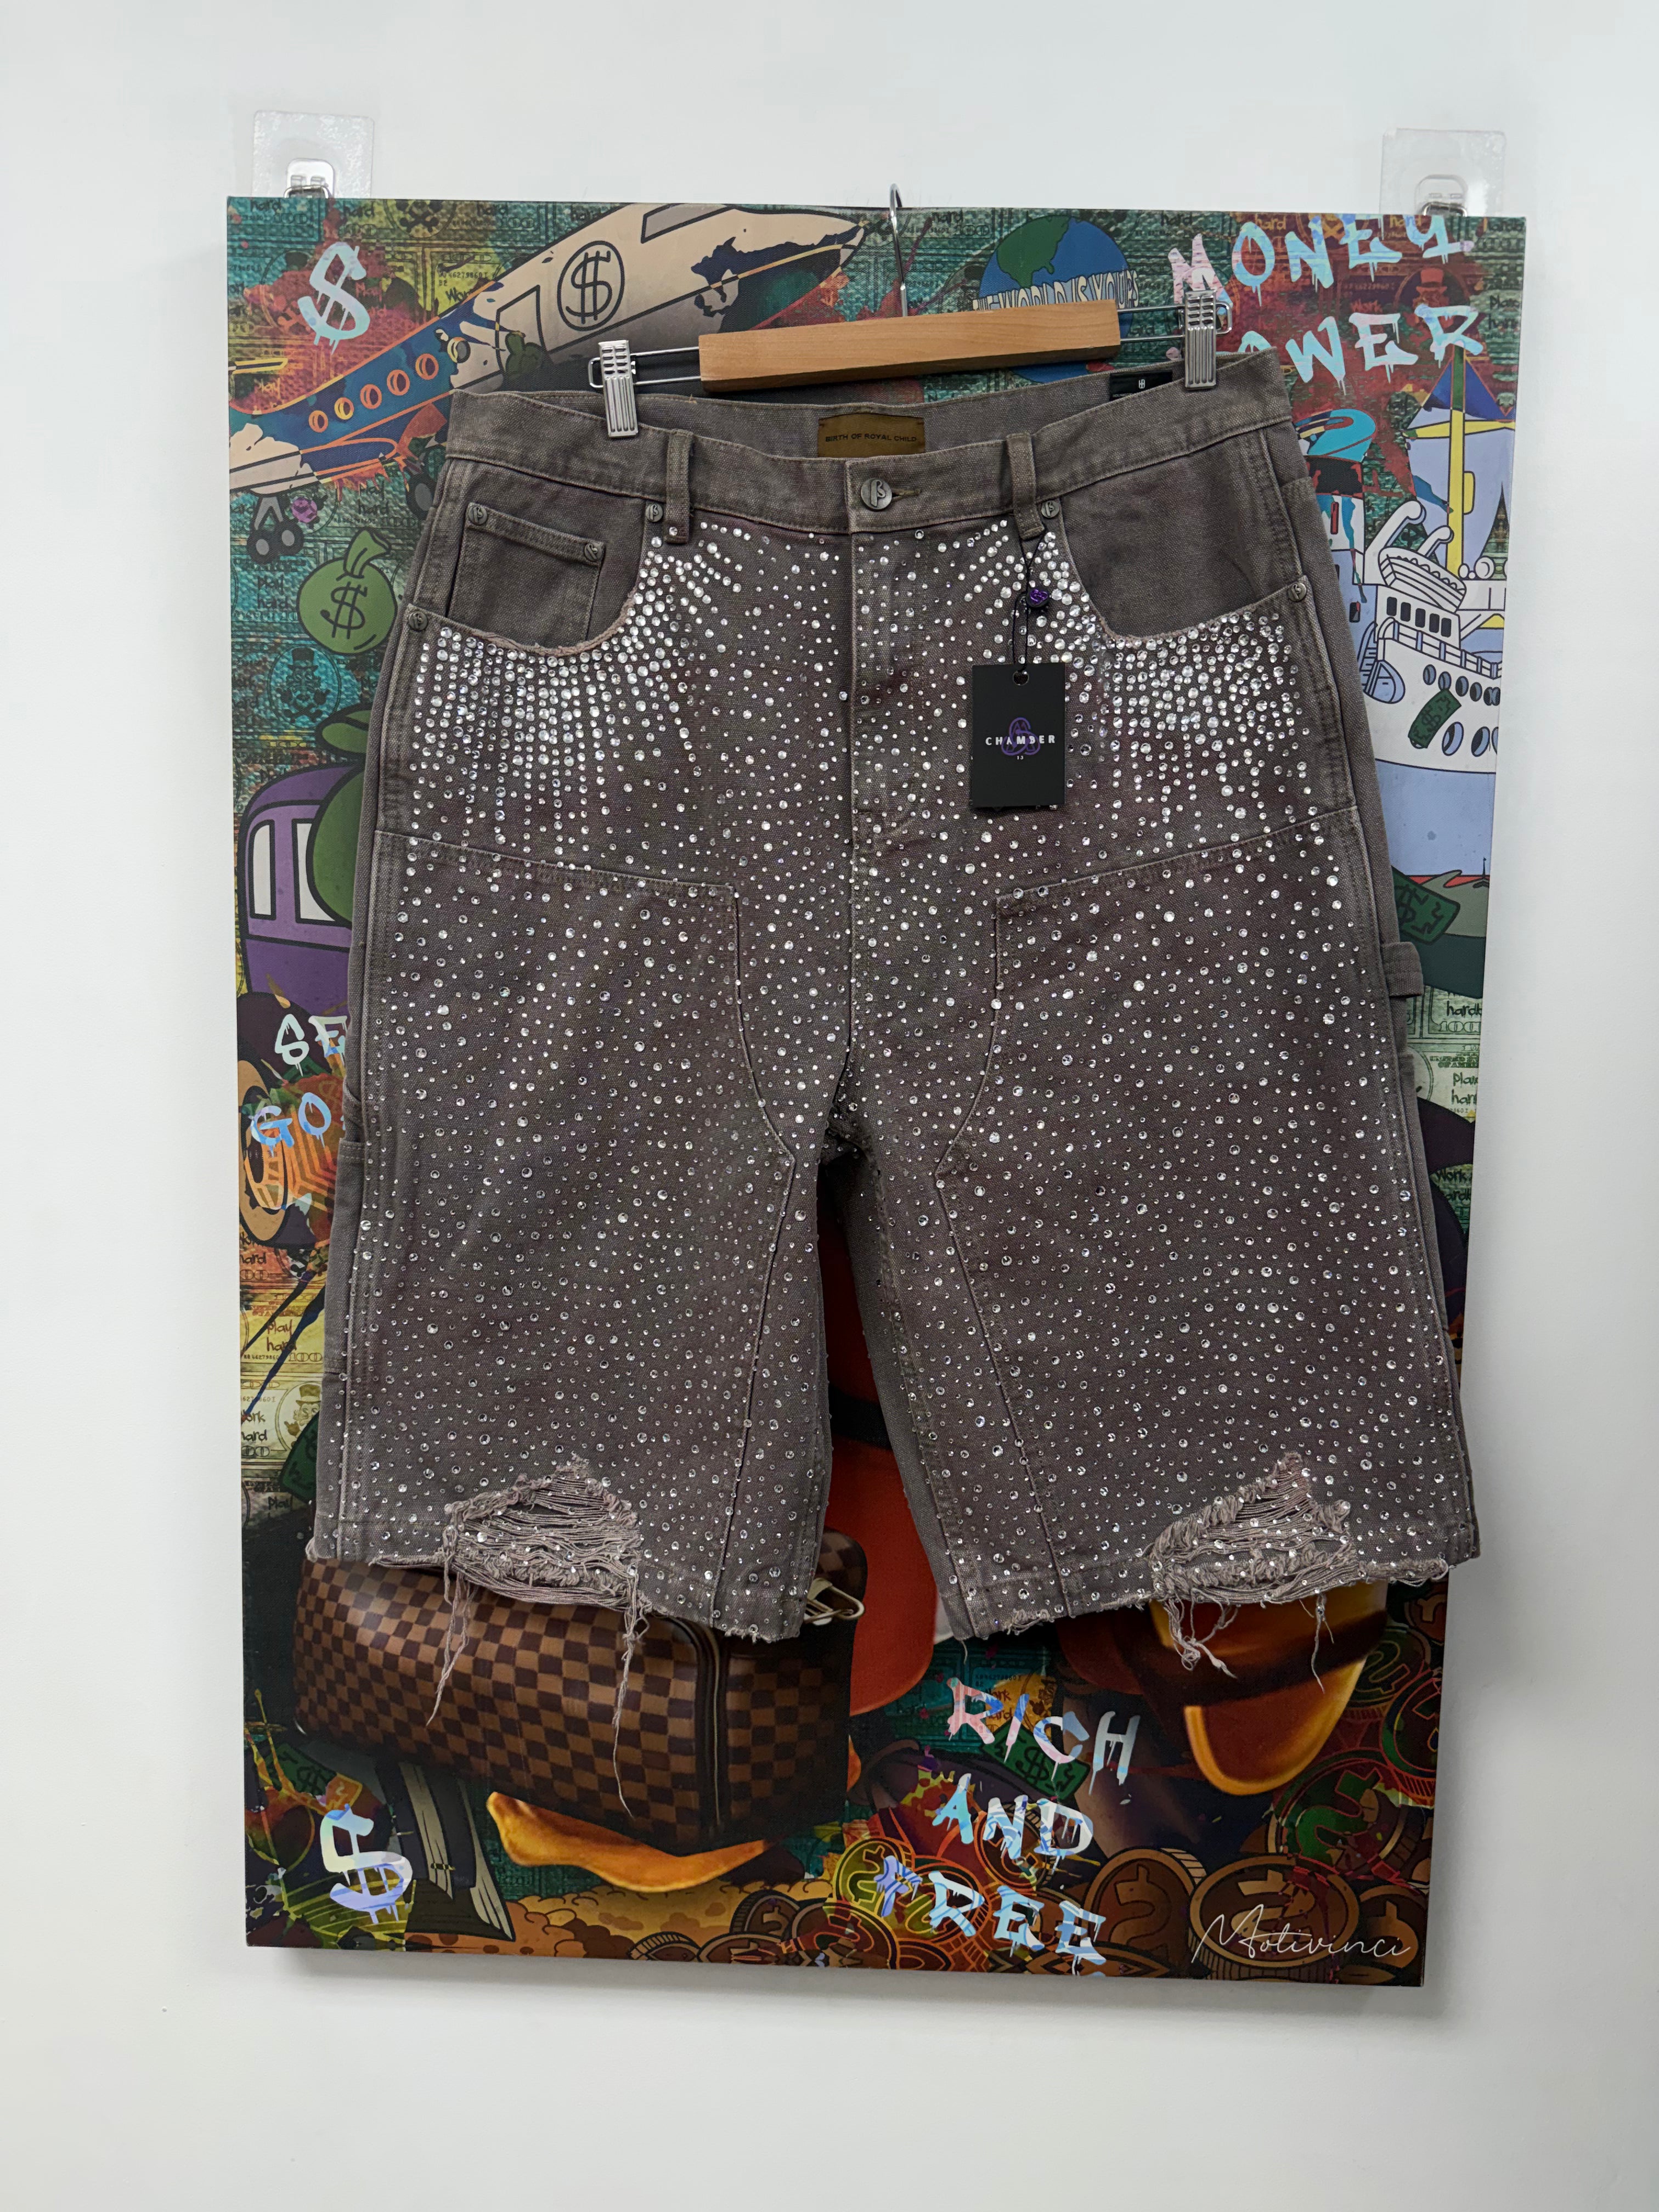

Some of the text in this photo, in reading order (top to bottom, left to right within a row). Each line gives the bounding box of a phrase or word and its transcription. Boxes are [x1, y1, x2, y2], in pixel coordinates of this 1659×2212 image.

[864, 433, 892, 441] ROYAL
[985, 735, 1056, 746] CHAMBER
[947, 1677, 1141, 1795] RICH
[932, 1773, 1093, 1875] AND
[873, 1855, 1107, 1976] FREE
[1191, 1903, 1411, 1963] Motivinci
